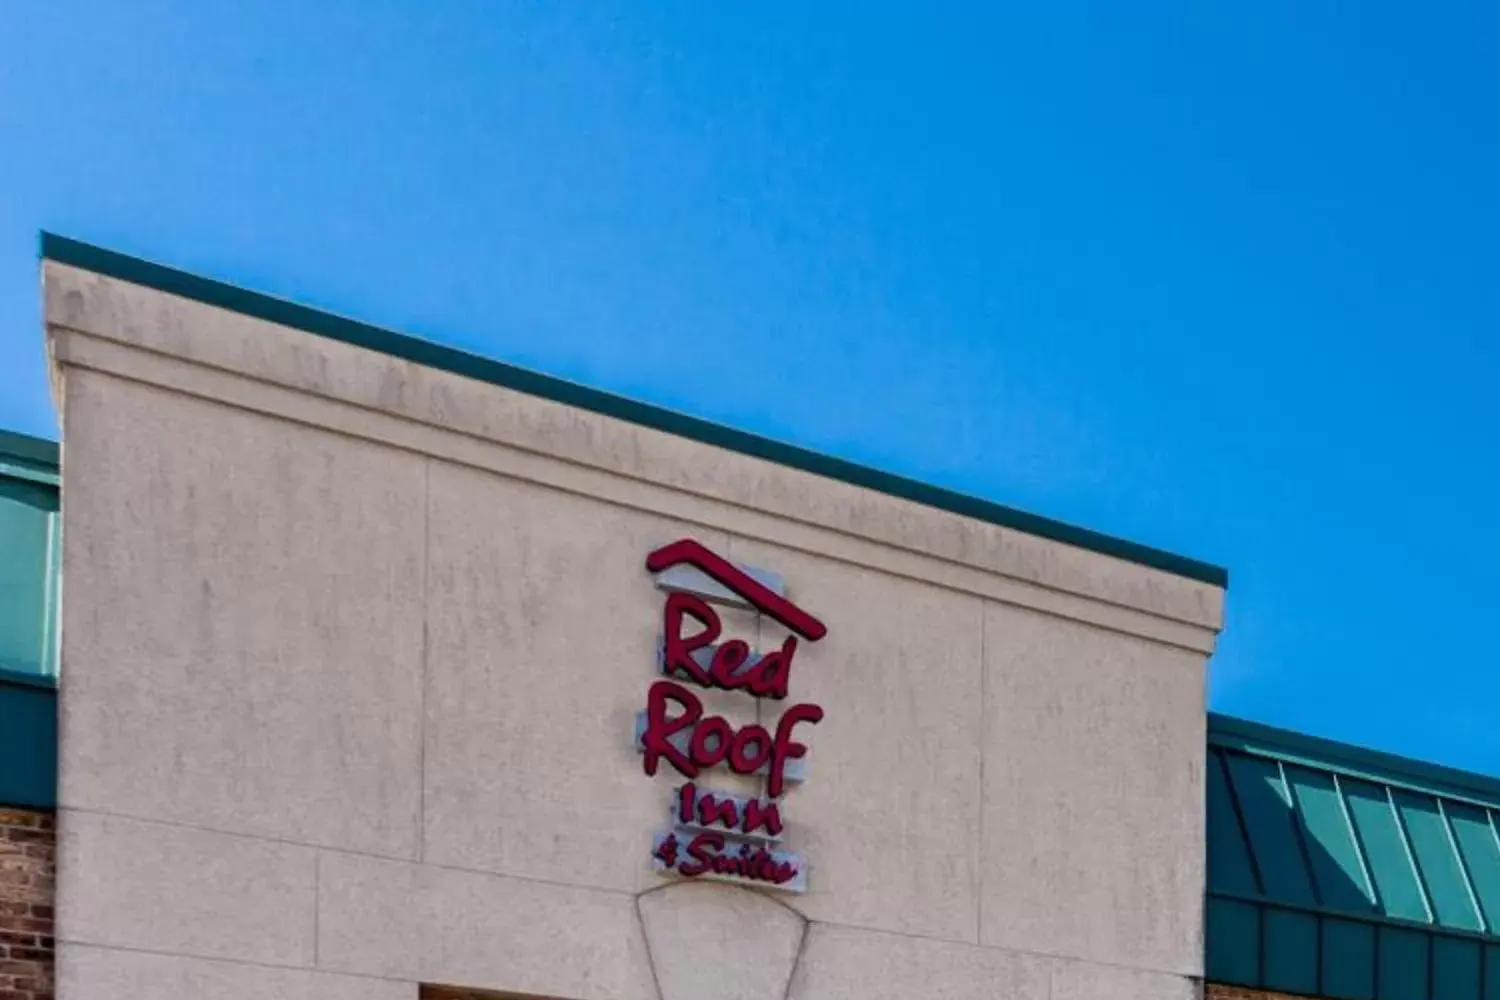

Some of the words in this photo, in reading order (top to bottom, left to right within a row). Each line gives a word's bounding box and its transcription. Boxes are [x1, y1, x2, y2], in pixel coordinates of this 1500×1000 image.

[664, 591, 798, 699] Red
[643, 680, 824, 798] Roof
[679, 781, 782, 836] Inn
